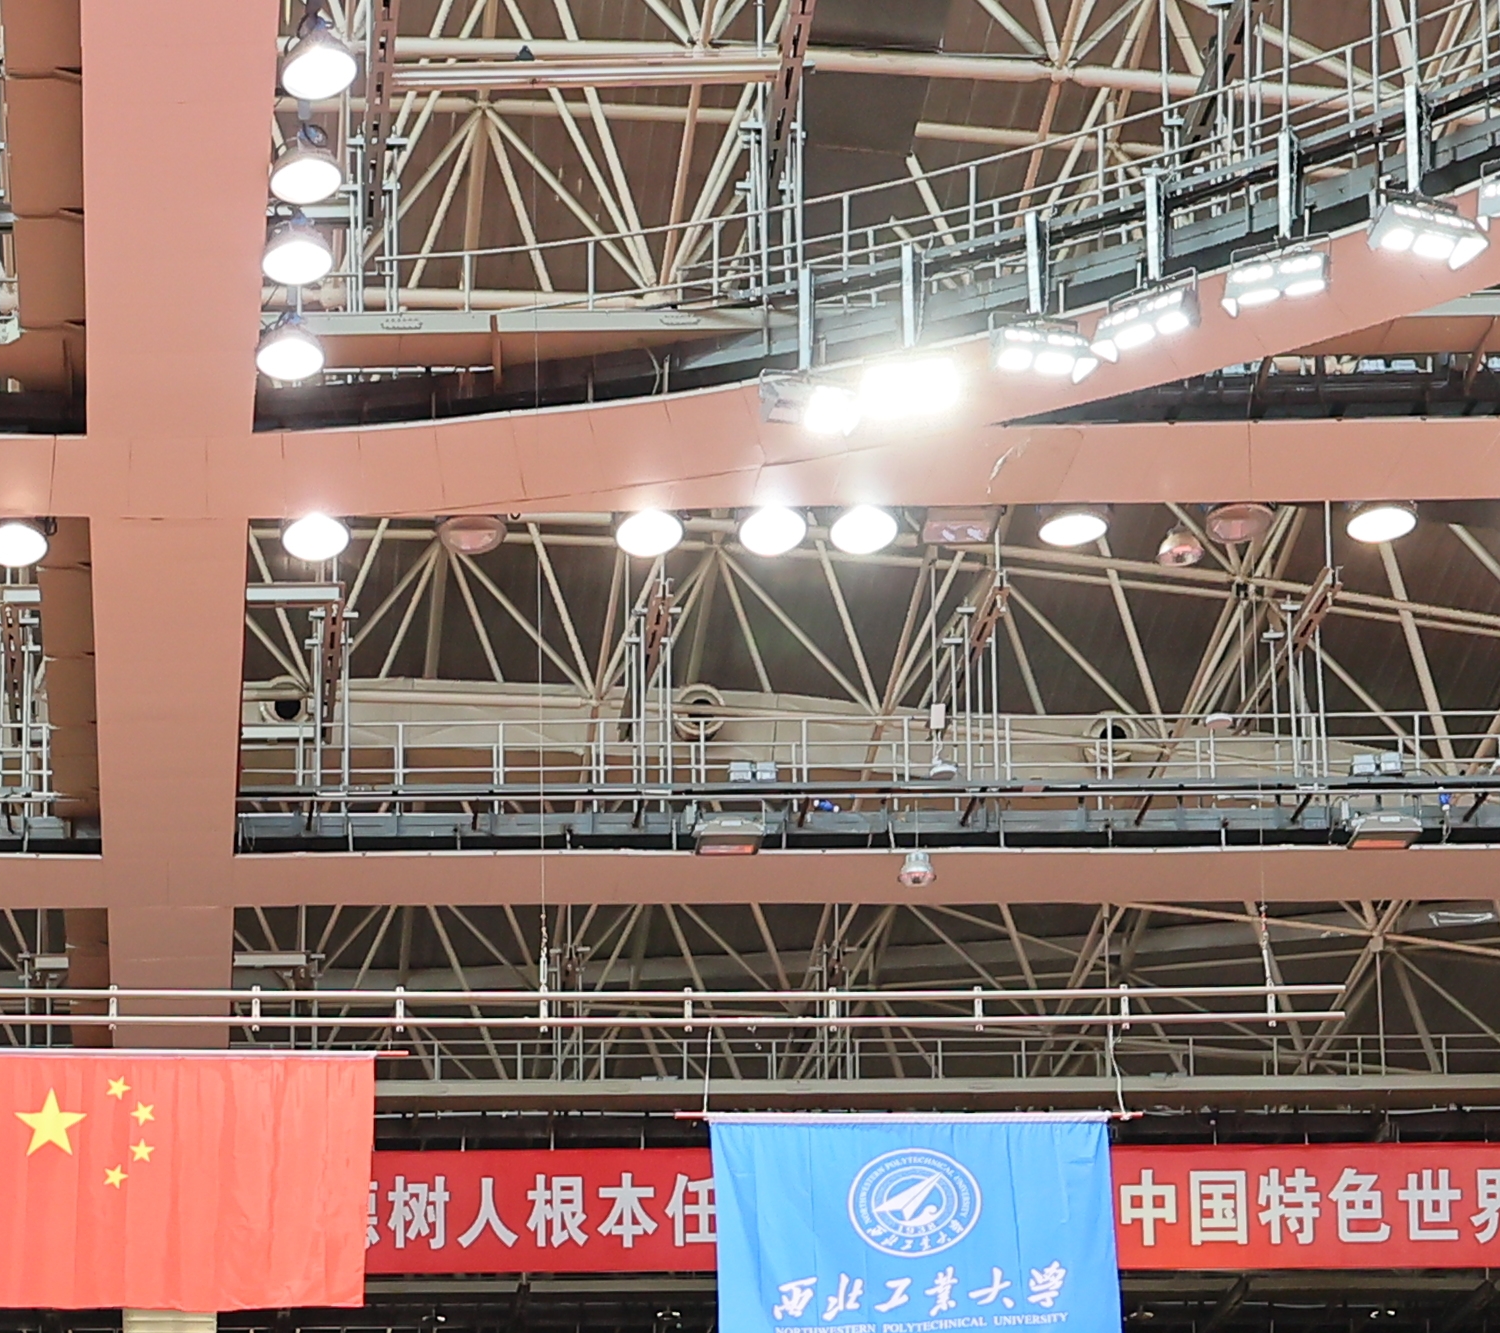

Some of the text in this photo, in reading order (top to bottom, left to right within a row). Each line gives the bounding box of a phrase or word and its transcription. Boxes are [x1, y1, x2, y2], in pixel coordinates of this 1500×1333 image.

[898, 1223, 938, 1234] 1938
[882, 1317, 987, 1333] POLYTECHNICAL
[993, 1312, 1069, 1327] UNIVERSITY
